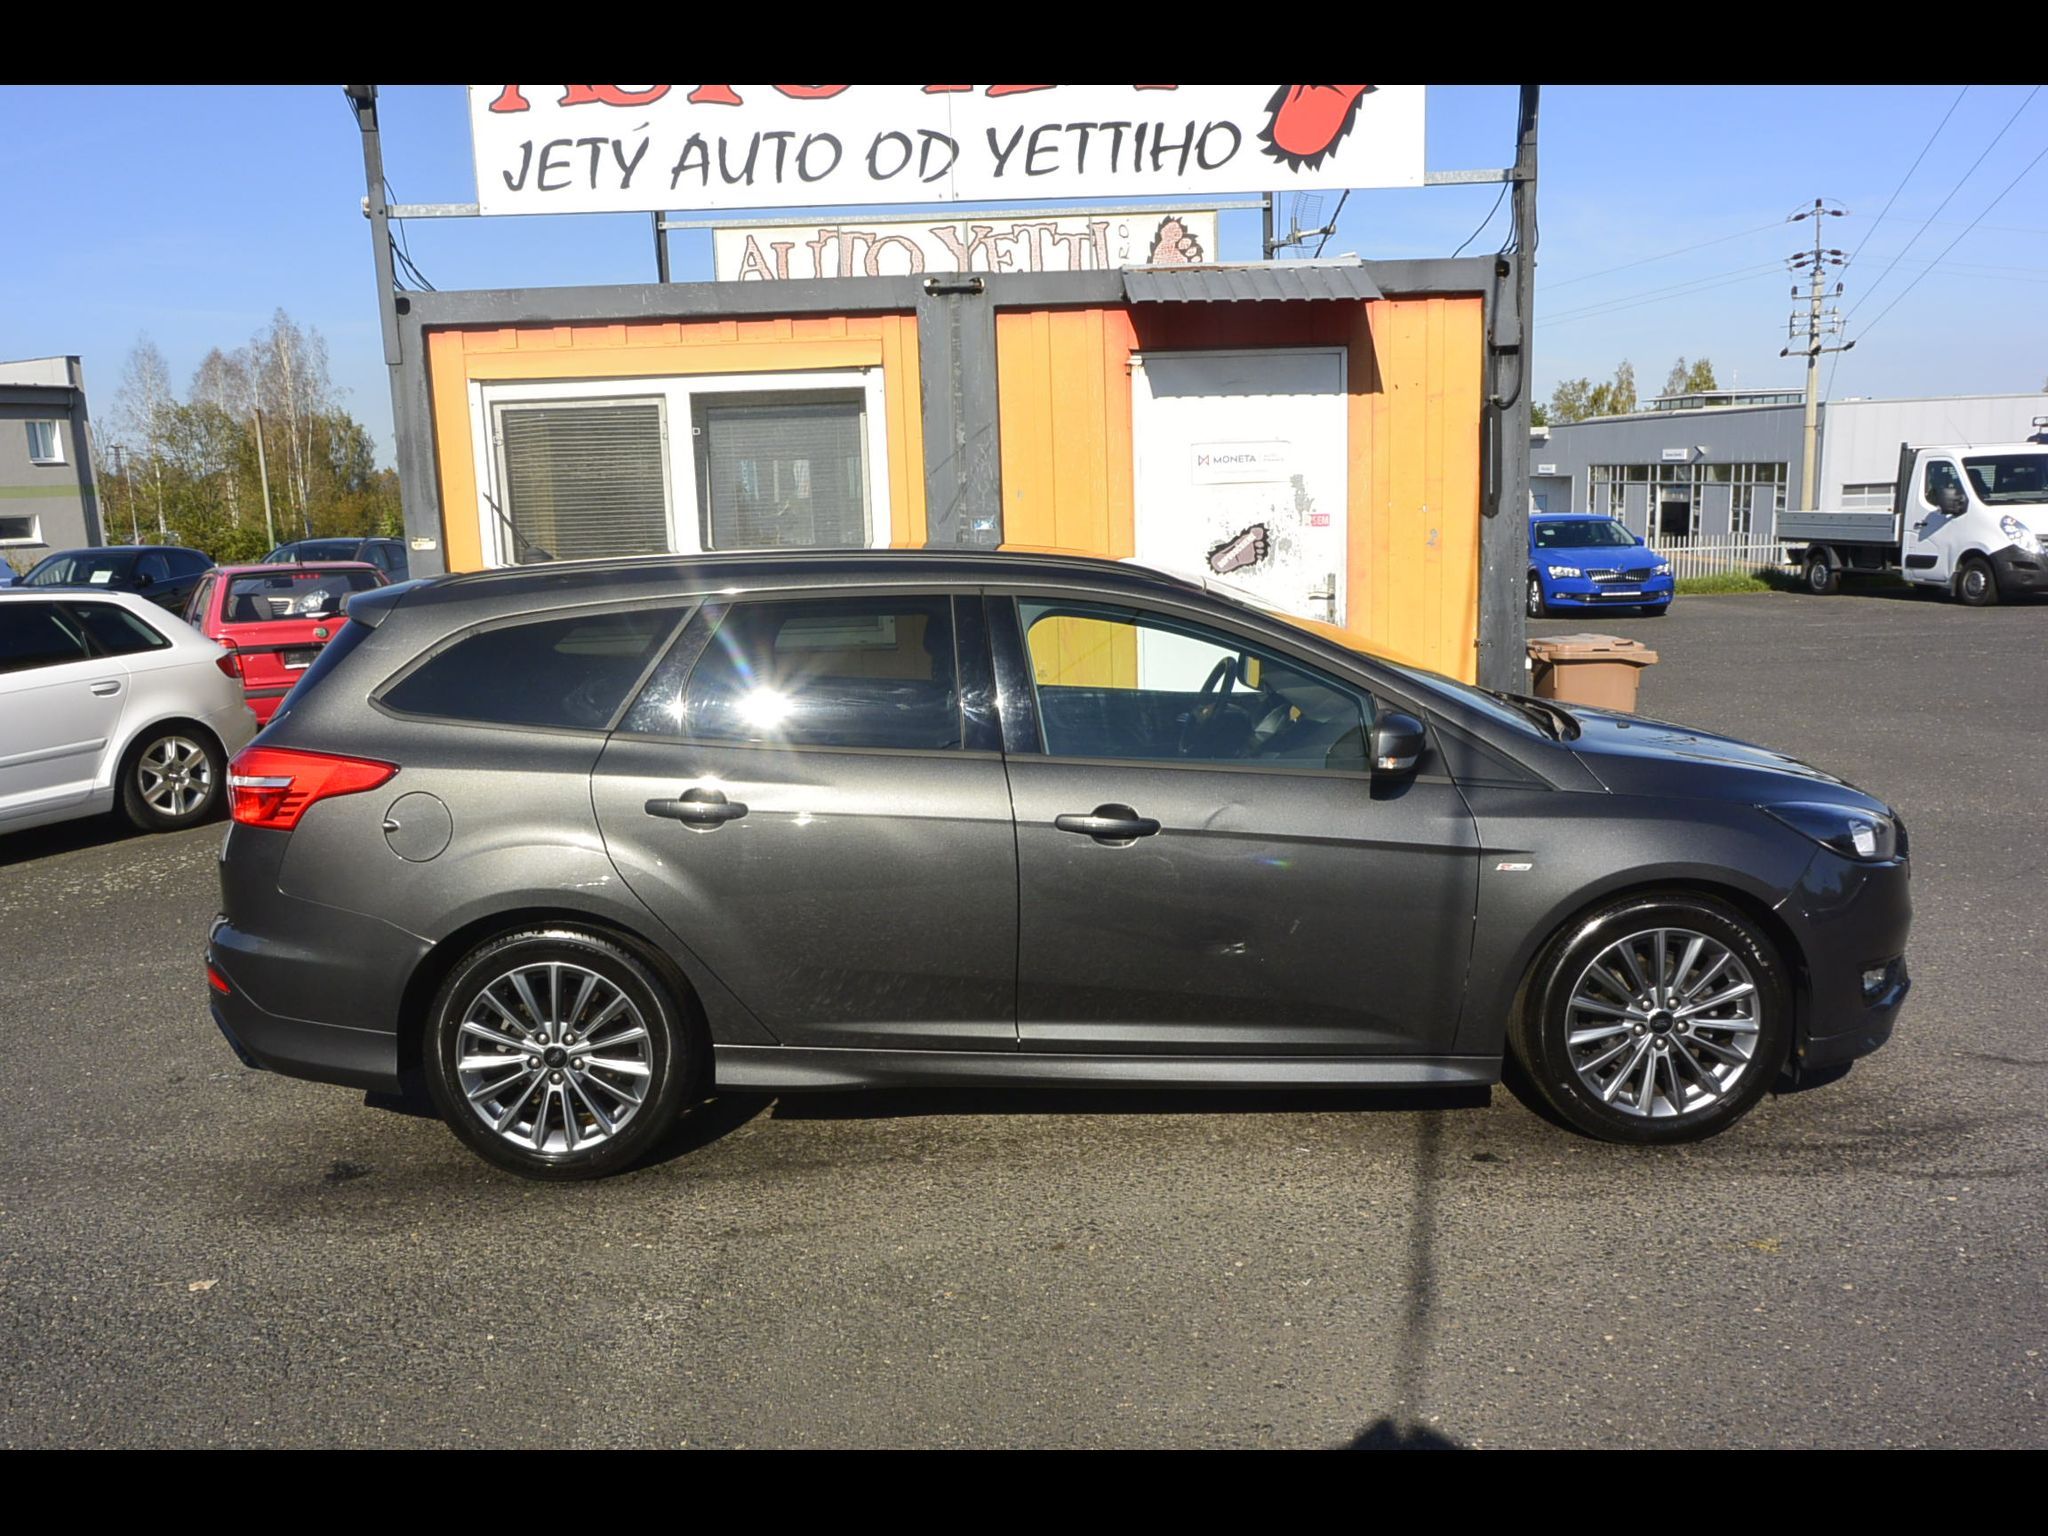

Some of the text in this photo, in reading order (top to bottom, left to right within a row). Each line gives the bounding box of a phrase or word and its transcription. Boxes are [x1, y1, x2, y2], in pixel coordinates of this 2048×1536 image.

[502, 120, 1242, 192] JETÝ AUTO OD YETTIHO
[738, 222, 1110, 282] AUTO YETTI
[1213, 454, 1257, 464] MONETA
